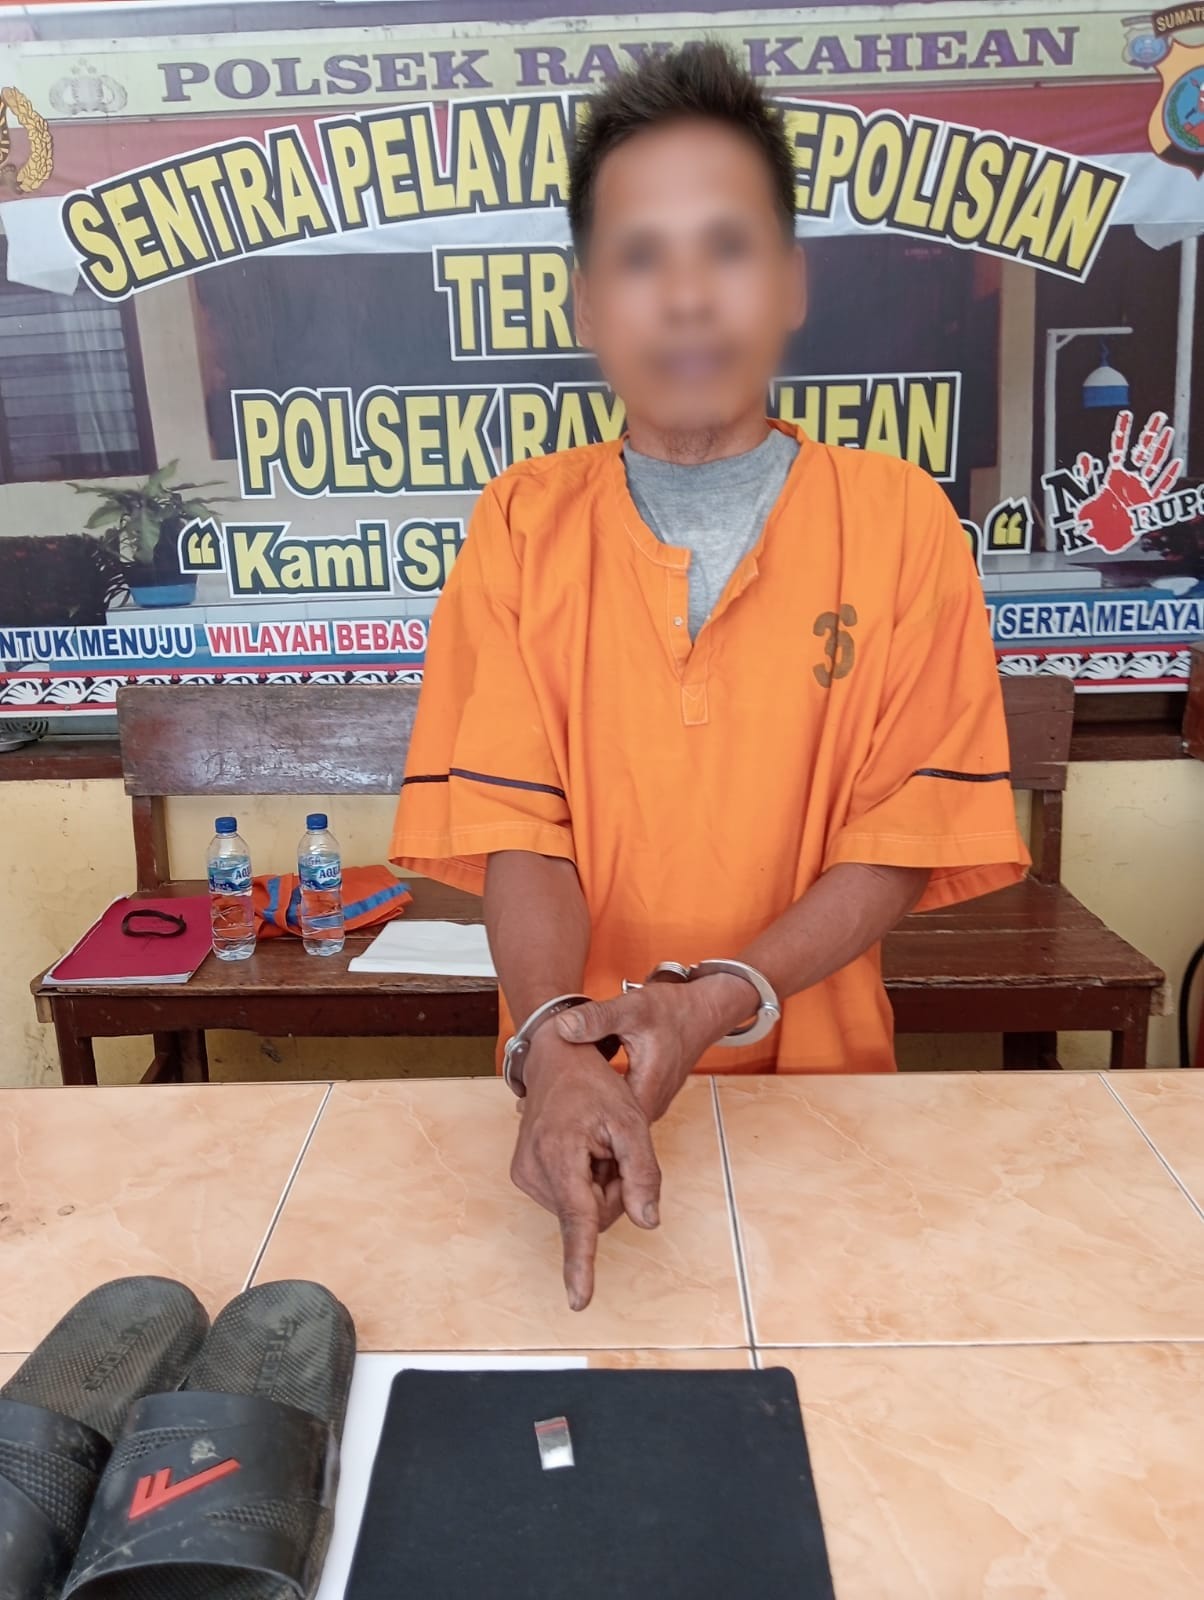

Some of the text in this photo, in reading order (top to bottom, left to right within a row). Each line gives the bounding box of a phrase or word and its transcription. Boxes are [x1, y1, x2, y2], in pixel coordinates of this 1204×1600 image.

[158, 49, 492, 102] POLSEK
[743, 26, 1080, 76] KAHEAN
[66, 100, 1114, 294] SENTRA PELAYA EPOLISIAN
[443, 252, 584, 350] TER
[242, 381, 951, 490] POLSEK RAY HEAN
[403, 527, 457, 586] Si
[0, 622, 424, 659] NTUK MENUJU WILAYAH BEBAS
[1001, 602, 1201, 635] SERTA MELAYA
